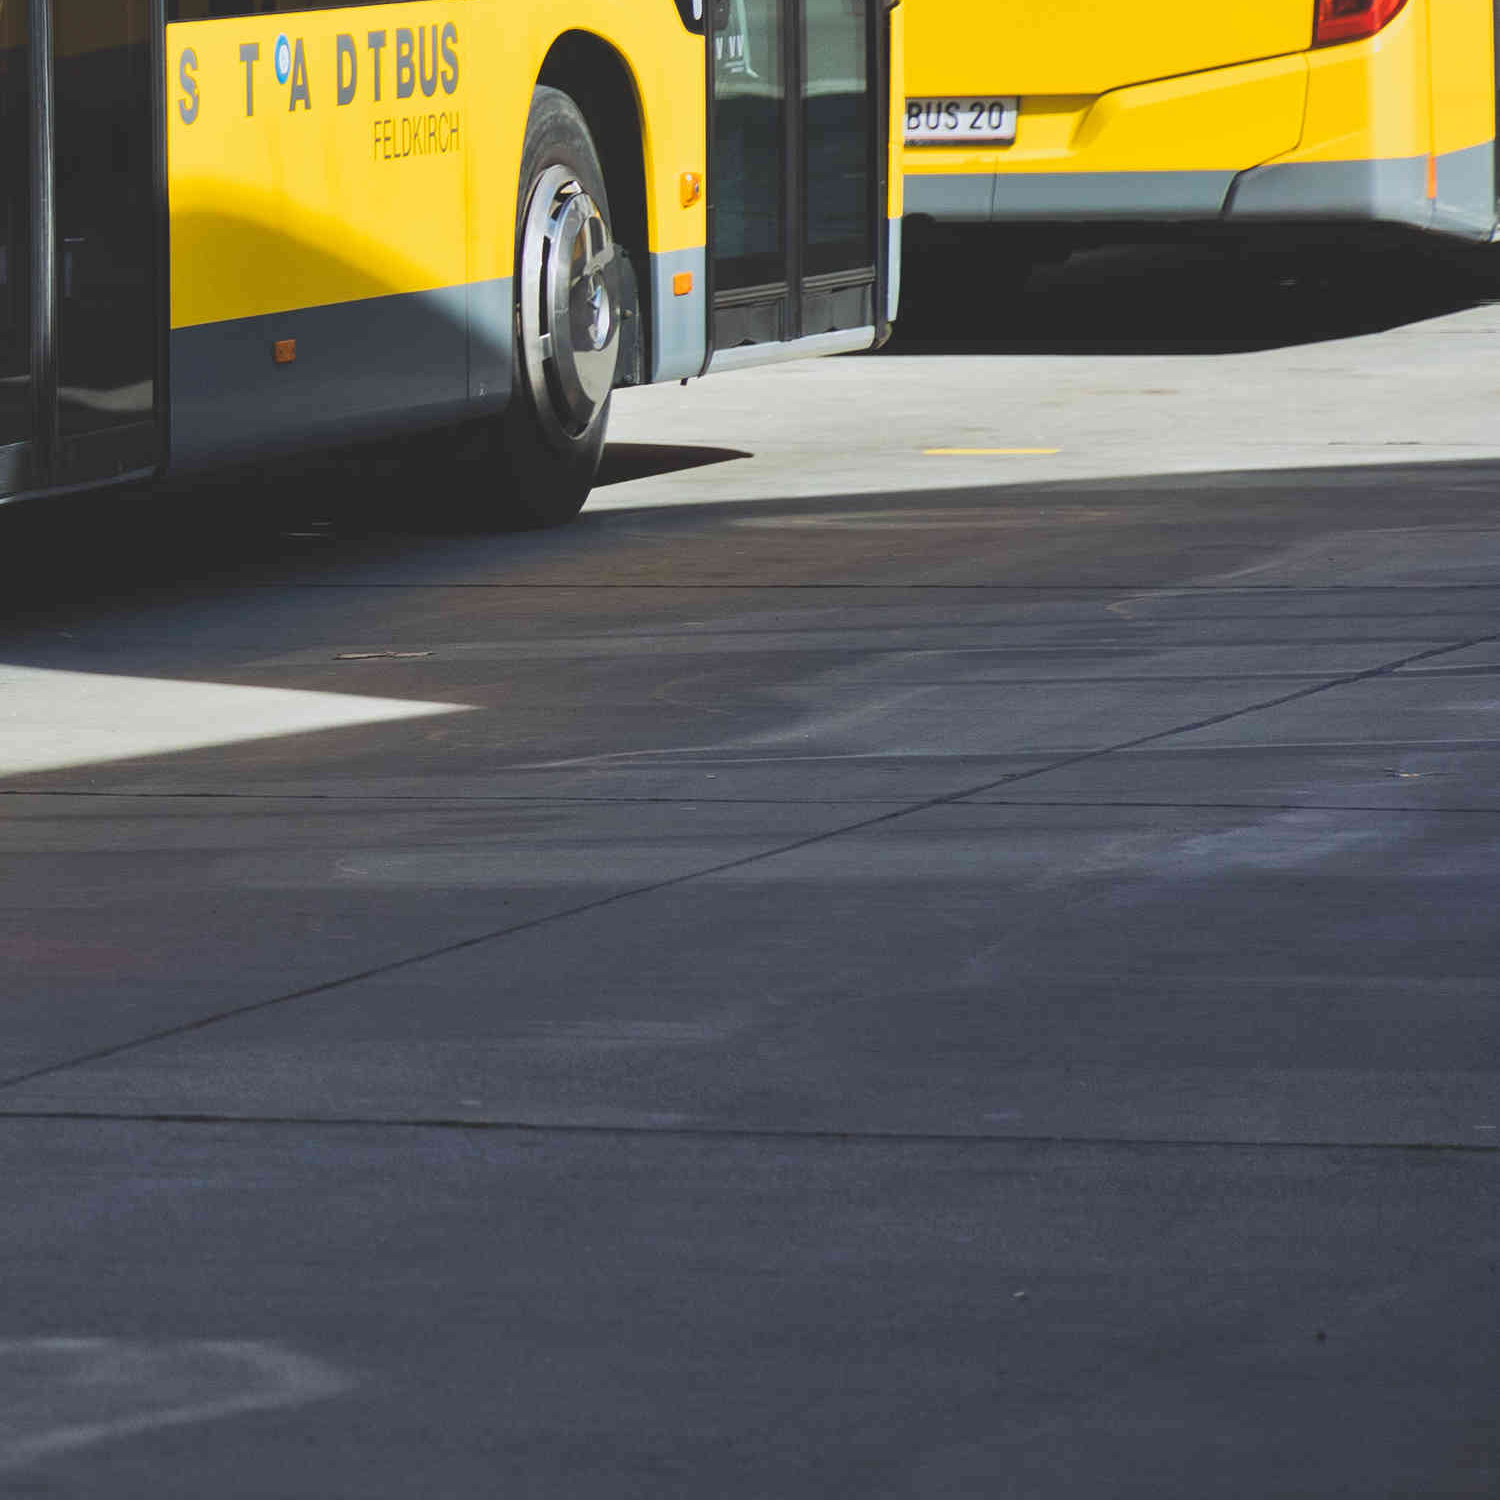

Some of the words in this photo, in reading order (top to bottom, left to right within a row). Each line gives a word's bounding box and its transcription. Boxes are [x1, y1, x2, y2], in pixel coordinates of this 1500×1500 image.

[907, 101, 960, 130] BUS
[969, 101, 1004, 130] 20
[374, 111, 460, 160] FELDKIRCH
